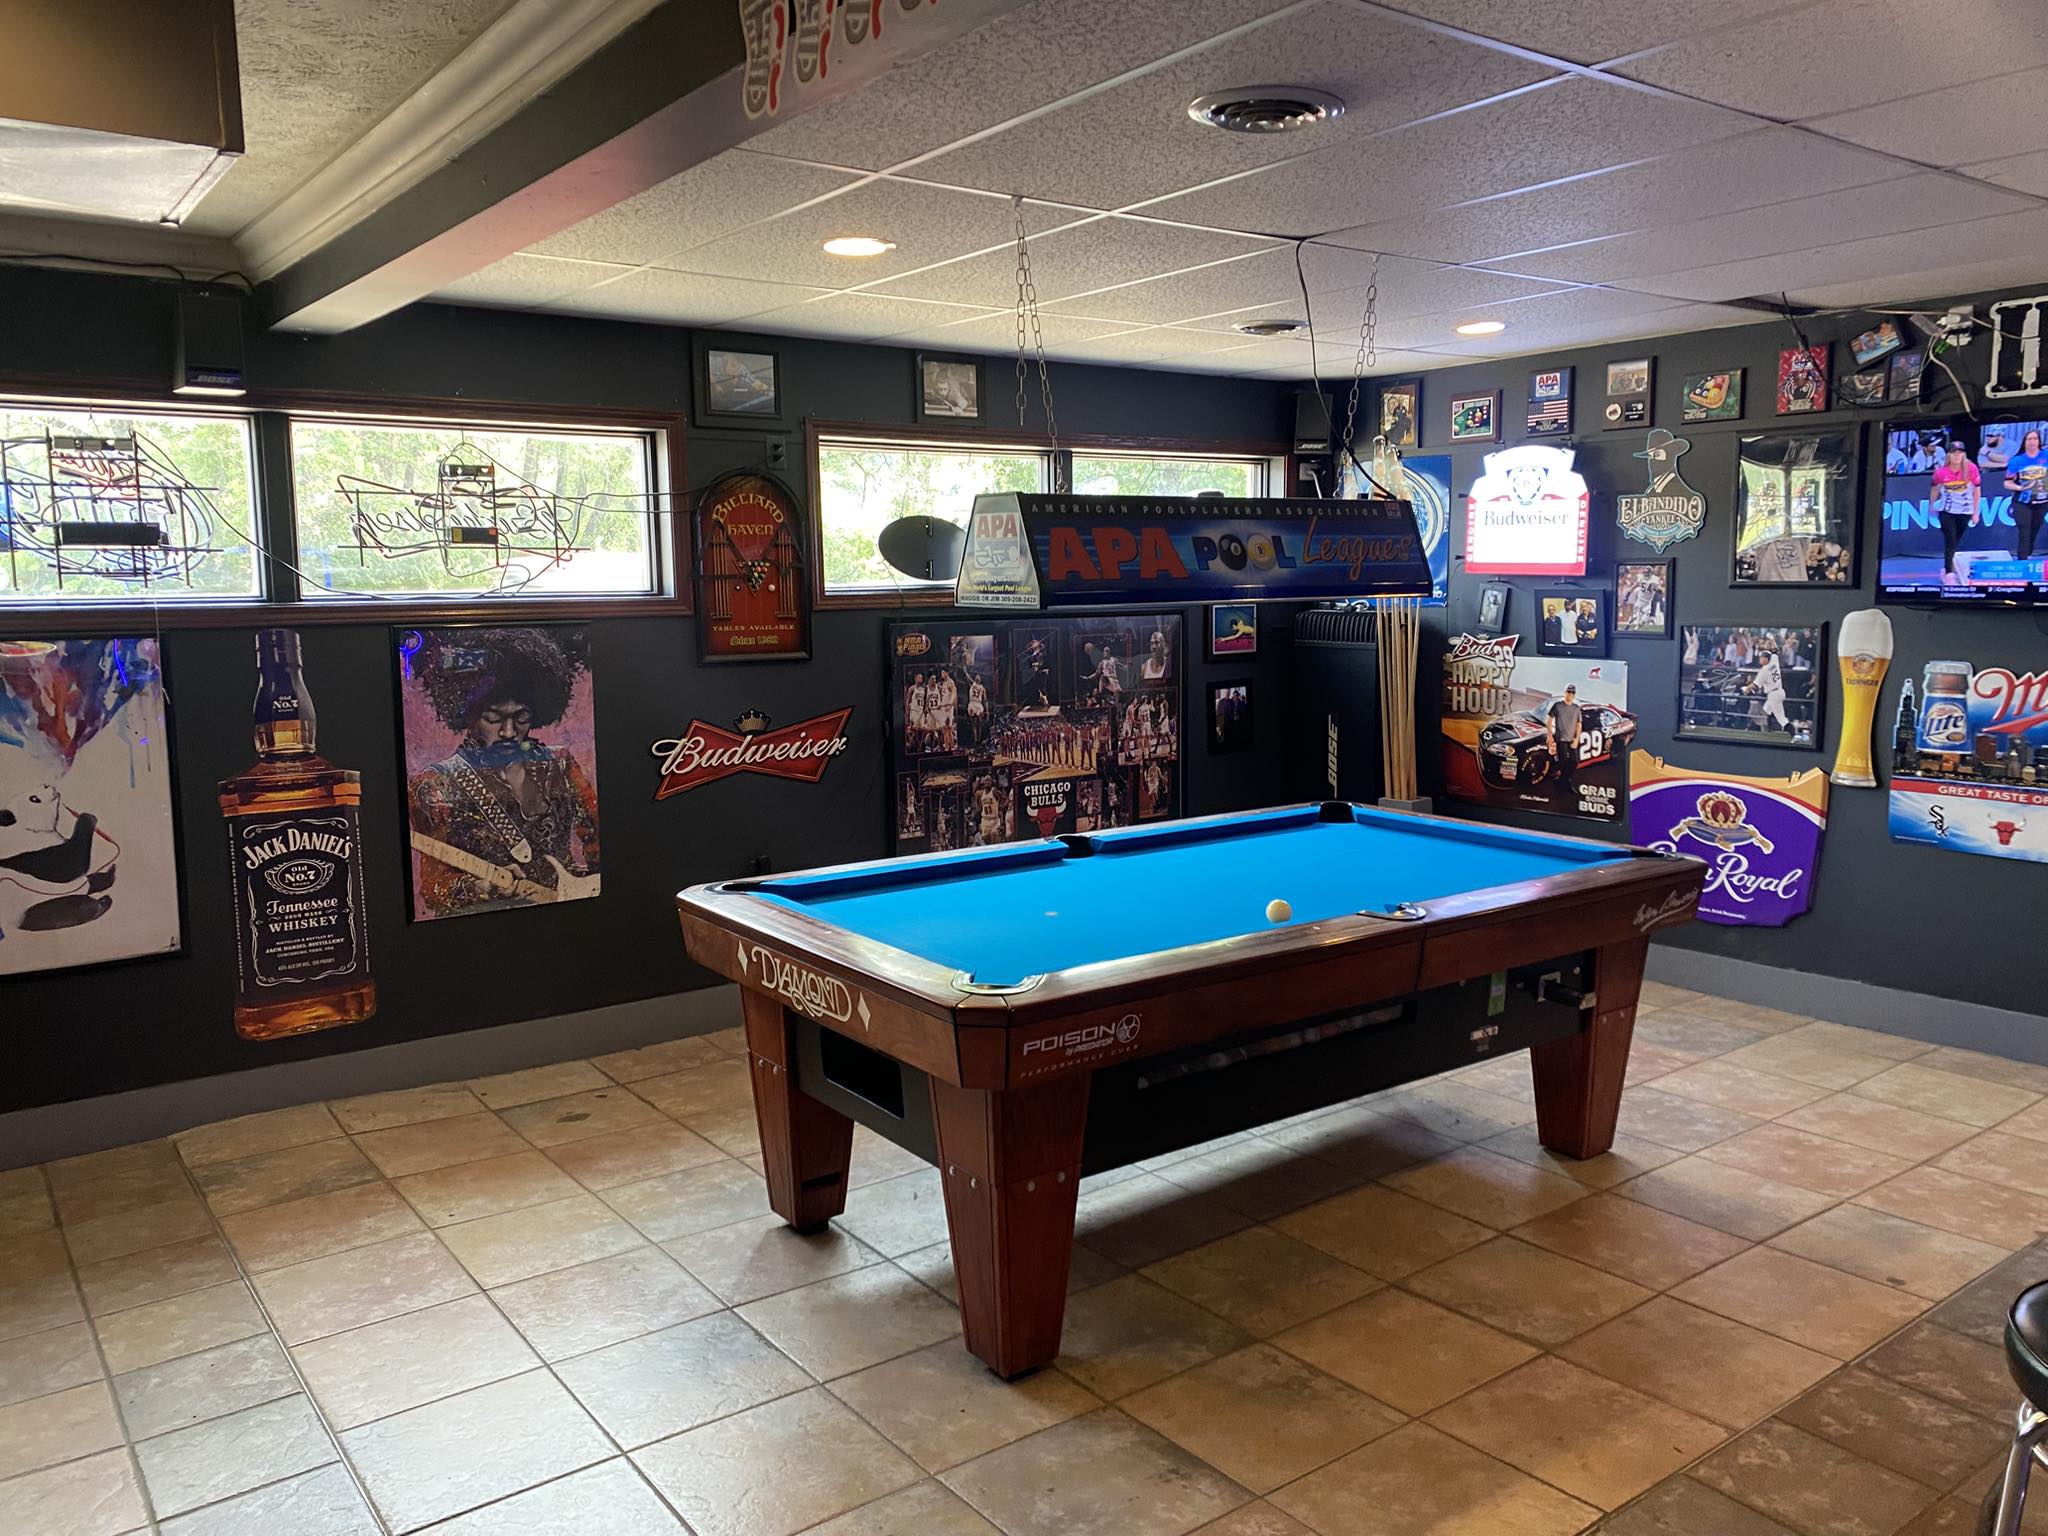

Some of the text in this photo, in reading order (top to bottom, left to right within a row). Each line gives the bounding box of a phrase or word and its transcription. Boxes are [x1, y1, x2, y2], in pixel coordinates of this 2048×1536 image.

[1538, 374, 1559, 386] APA
[711, 493, 784, 524] BILLIARD
[1032, 503, 1128, 514] AMERICAN
[1143, 503, 1263, 515] POOLPLAYERS
[1275, 506, 1378, 517] ASSOCIATION
[1484, 509, 1569, 527] Budweiser
[976, 514, 1018, 538] APA
[1645, 514, 1677, 526] YANKEE
[1049, 526, 1189, 581] APA
[1303, 514, 1414, 581] Leagues
[1448, 637, 1493, 657] Bud
[1452, 661, 1513, 687] HAPPY
[1452, 685, 1513, 715] HOUR
[1926, 714, 1964, 736] Lite
[651, 731, 847, 776] Budweiser
[1579, 730, 1603, 761] 29
[1328, 713, 1338, 799] BOSE
[1023, 781, 1071, 797] CHICAGO
[1579, 783, 1617, 799] GRAB
[1938, 785, 1981, 798] GREAT
[1987, 789, 2029, 804] TASTE
[1030, 793, 1064, 808] BULLS
[1578, 801, 1616, 816] BUDS
[243, 829, 353, 869] JACK DANIEL'S
[284, 870, 316, 883] No.7
[291, 864, 308, 872] Old
[1702, 852, 1803, 903] Royal
[266, 898, 338, 915] Tennessee
[268, 915, 338, 933] WHISKEY
[751, 945, 852, 1023] DIAMOND
[1023, 1021, 1116, 1056] POISON
